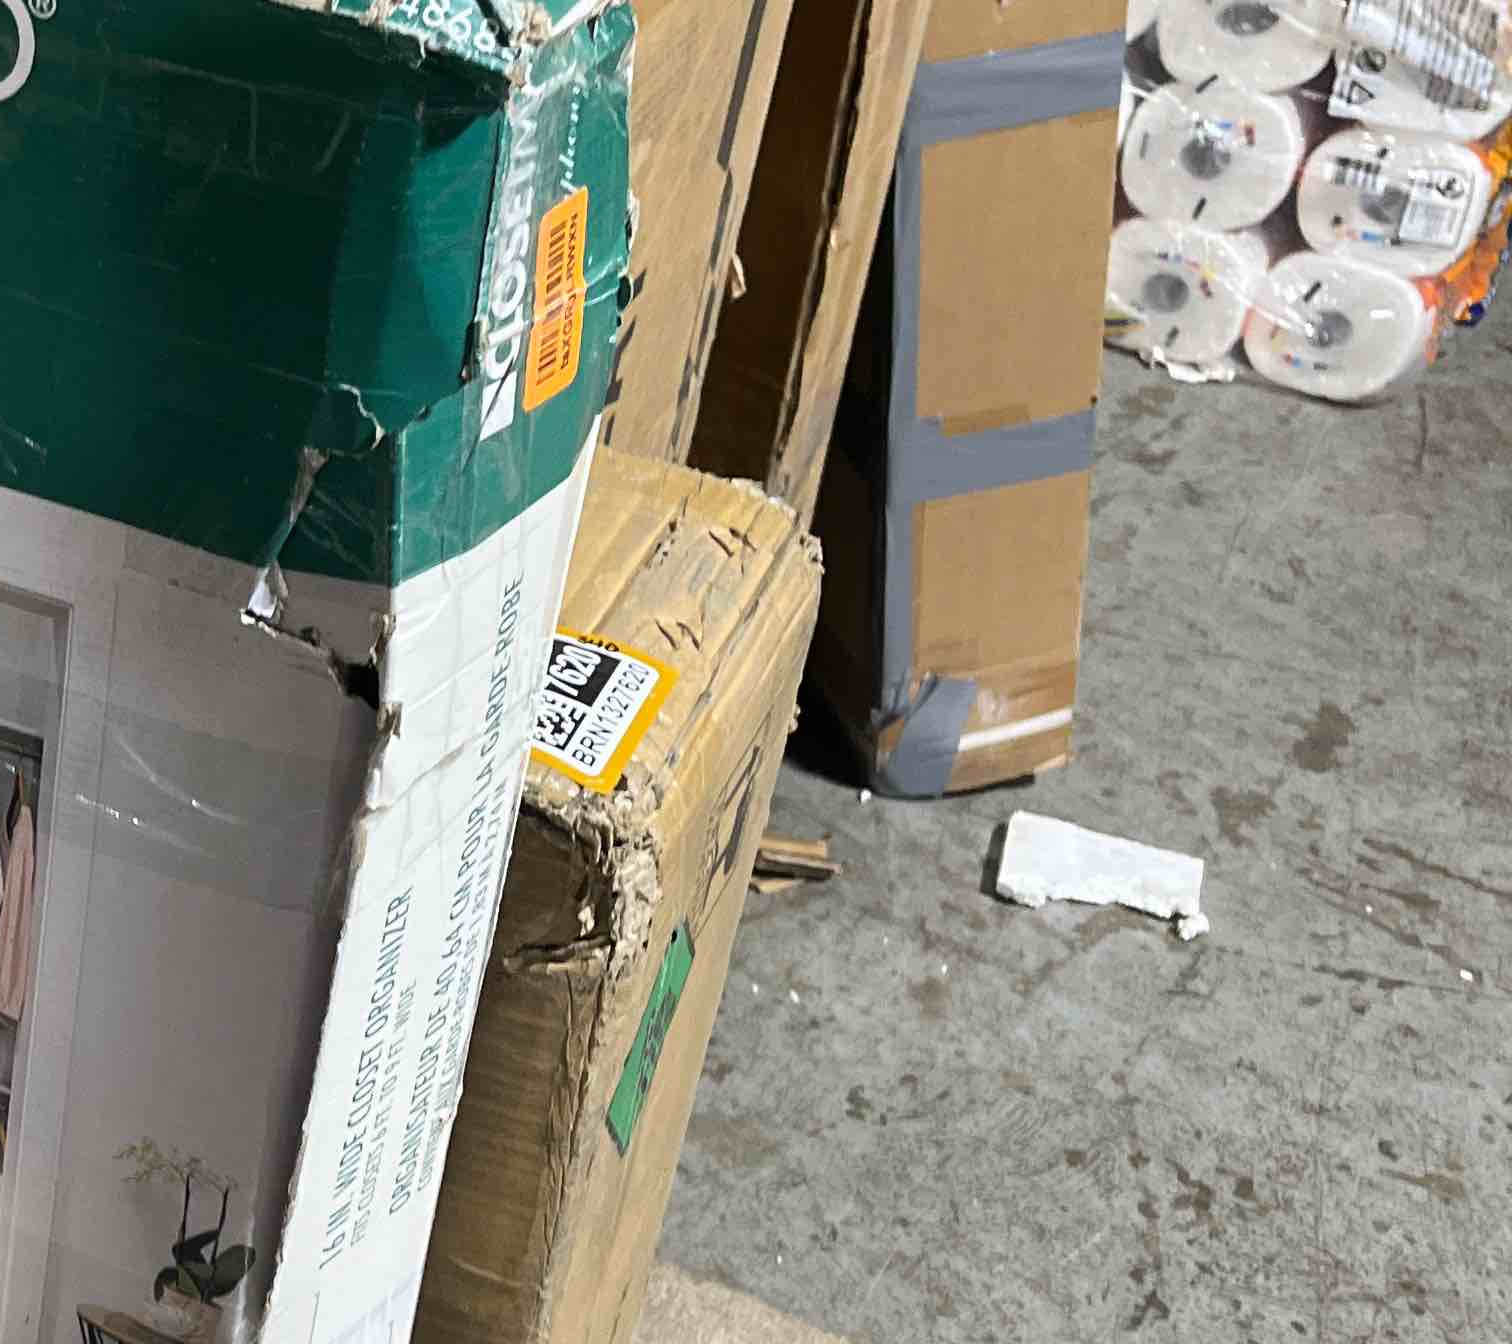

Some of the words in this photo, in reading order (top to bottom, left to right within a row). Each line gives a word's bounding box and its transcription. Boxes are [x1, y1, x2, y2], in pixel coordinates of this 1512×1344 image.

[480, 567, 525, 758] GARDE-ROBE
[571, 661, 651, 768] BRN1327620
[471, 757, 495, 799] LA
[457, 798, 489, 877] POUR
[449, 876, 474, 920] CM
[365, 884, 414, 1038] ORGANIZER
[425, 996, 451, 1040] DE
[347, 1038, 385, 1129] CLOSET
[389, 1035, 443, 1216] ORGANISATEUR
[332, 1124, 368, 1200] WIDE
